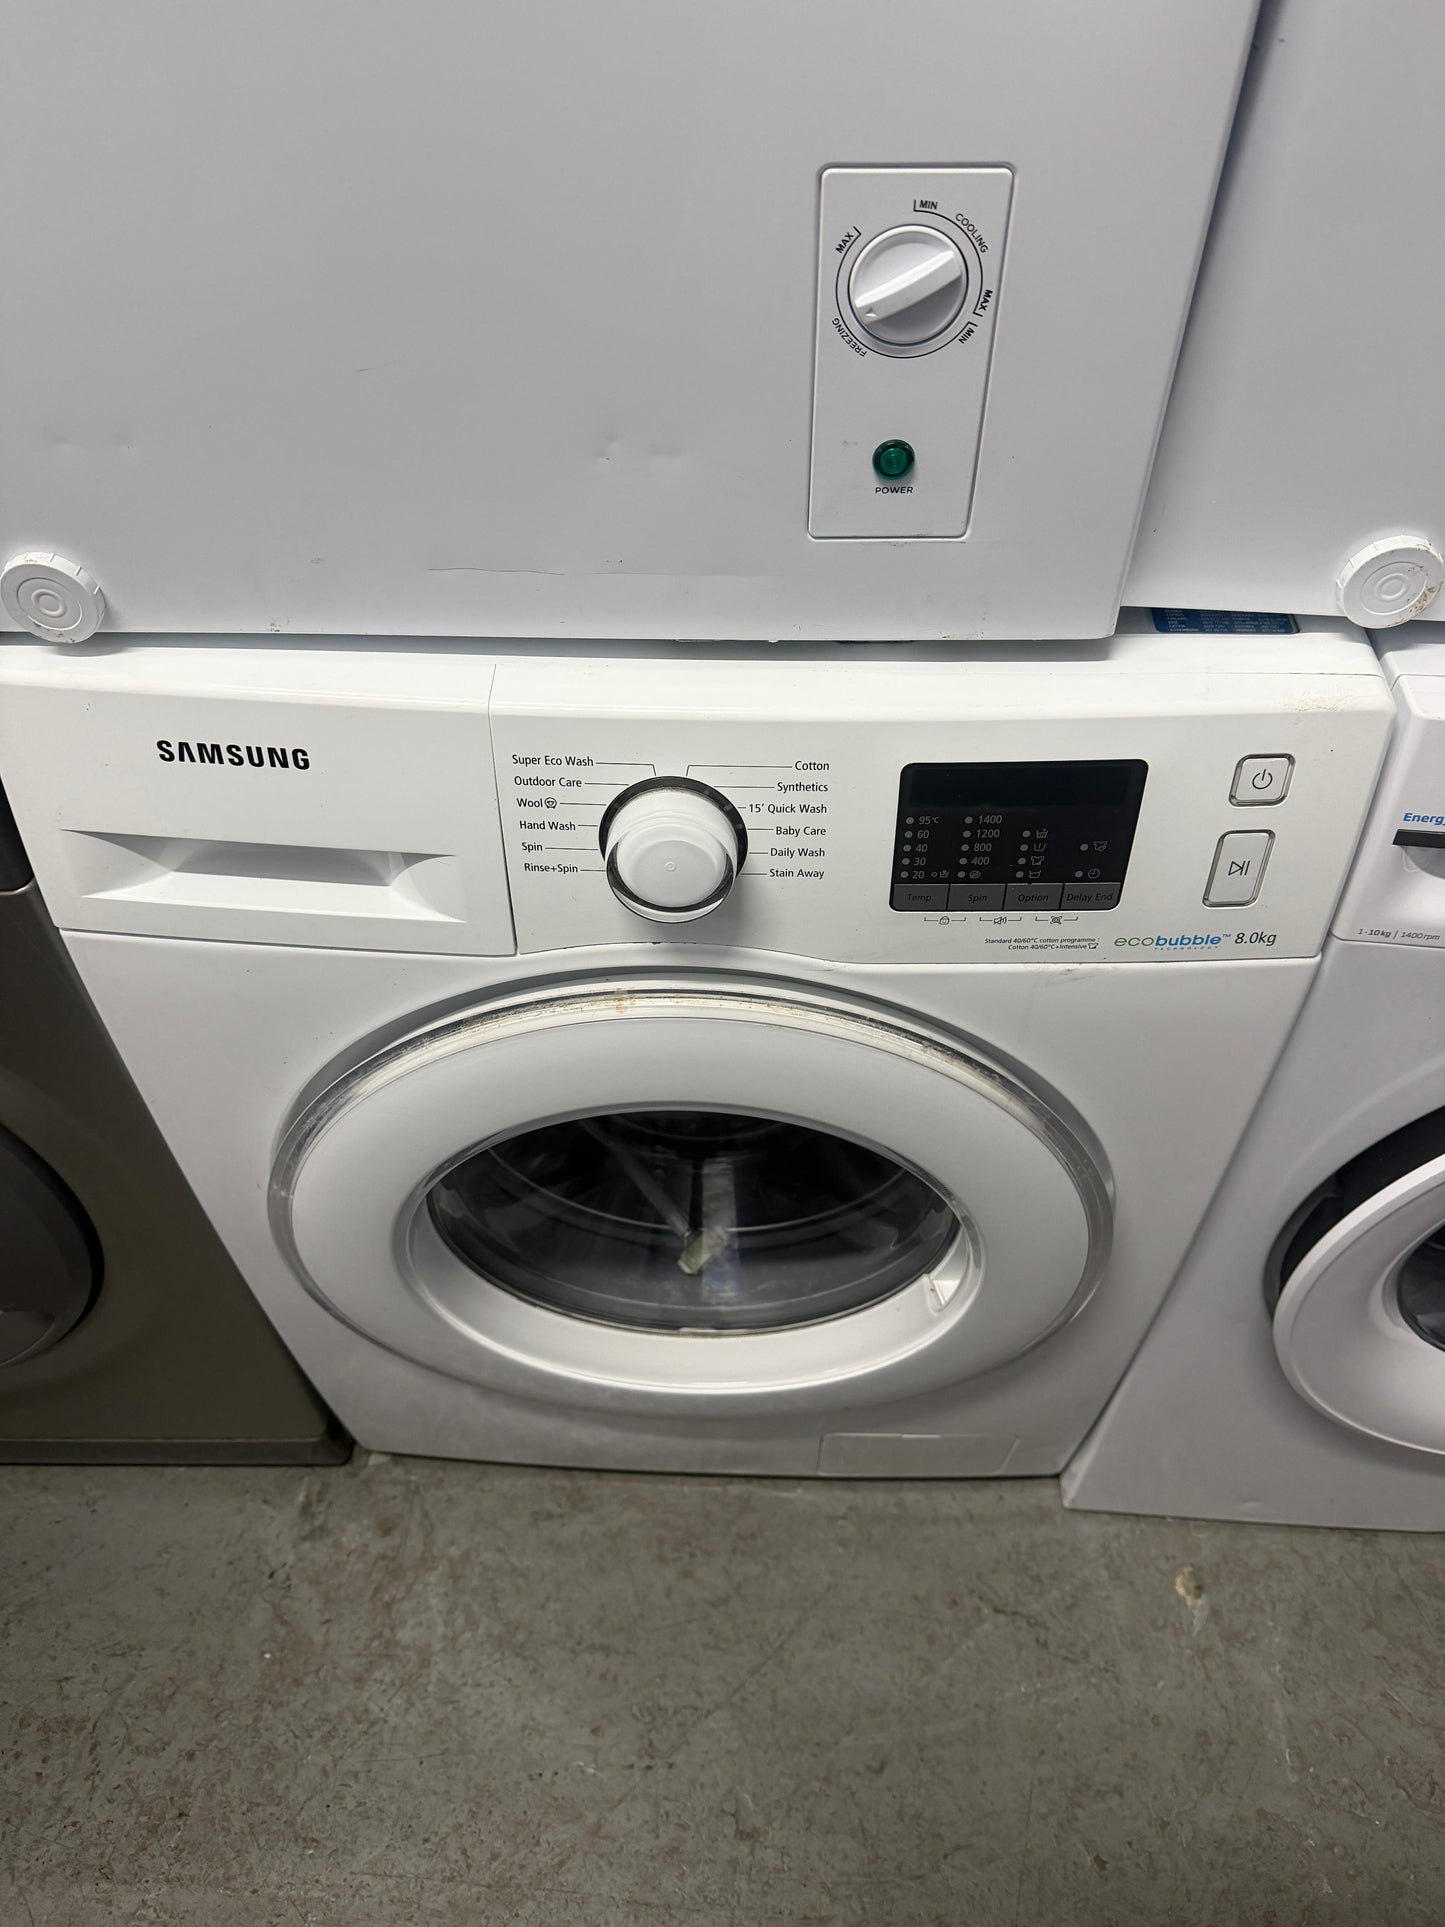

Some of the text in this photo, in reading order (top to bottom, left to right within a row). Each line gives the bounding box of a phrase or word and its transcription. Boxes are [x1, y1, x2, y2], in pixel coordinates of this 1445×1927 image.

[919, 199, 938, 210] MIN
[955, 212, 989, 254] COOLING
[835, 231, 854, 254] MAX
[978, 289, 994, 311] MAX
[831, 317, 868, 357] FREEZING
[958, 327, 975, 344] MIN
[875, 486, 914, 495] POWER
[156, 739, 310, 770] SAMSUNG
[511, 754, 594, 767] Super Eco Wash
[794, 760, 830, 771] Cotton
[514, 775, 582, 788] Outdoor Care
[777, 781, 829, 794] Synthetics
[516, 797, 543, 808] Wool
[767, 803, 796, 815] Quick
[798, 803, 828, 814] Wash
[918, 815, 939, 825] 95°C
[978, 814, 1003, 824] 1400
[1403, 812, 1445, 826] Energ
[519, 820, 576, 831] Hand Wash
[775, 825, 827, 838] Baby Care
[917, 829, 930, 839] 60
[976, 828, 1001, 838] 1200
[521, 841, 543, 853] Spin
[770, 847, 826, 859] Daily Wash
[915, 843, 928, 853] 40
[973, 842, 992, 852] 800
[913, 857, 926, 866] 30
[971, 856, 990, 866] 400
[524, 862, 579, 875] Rinse+Spin
[769, 868, 825, 880] Stain Away
[911, 870, 925, 879] 20
[968, 893, 988, 904] Spin
[1017, 893, 1049, 903] Option
[1066, 892, 1114, 904] Delay End
[1234, 931, 1278, 947] 8.0kg
